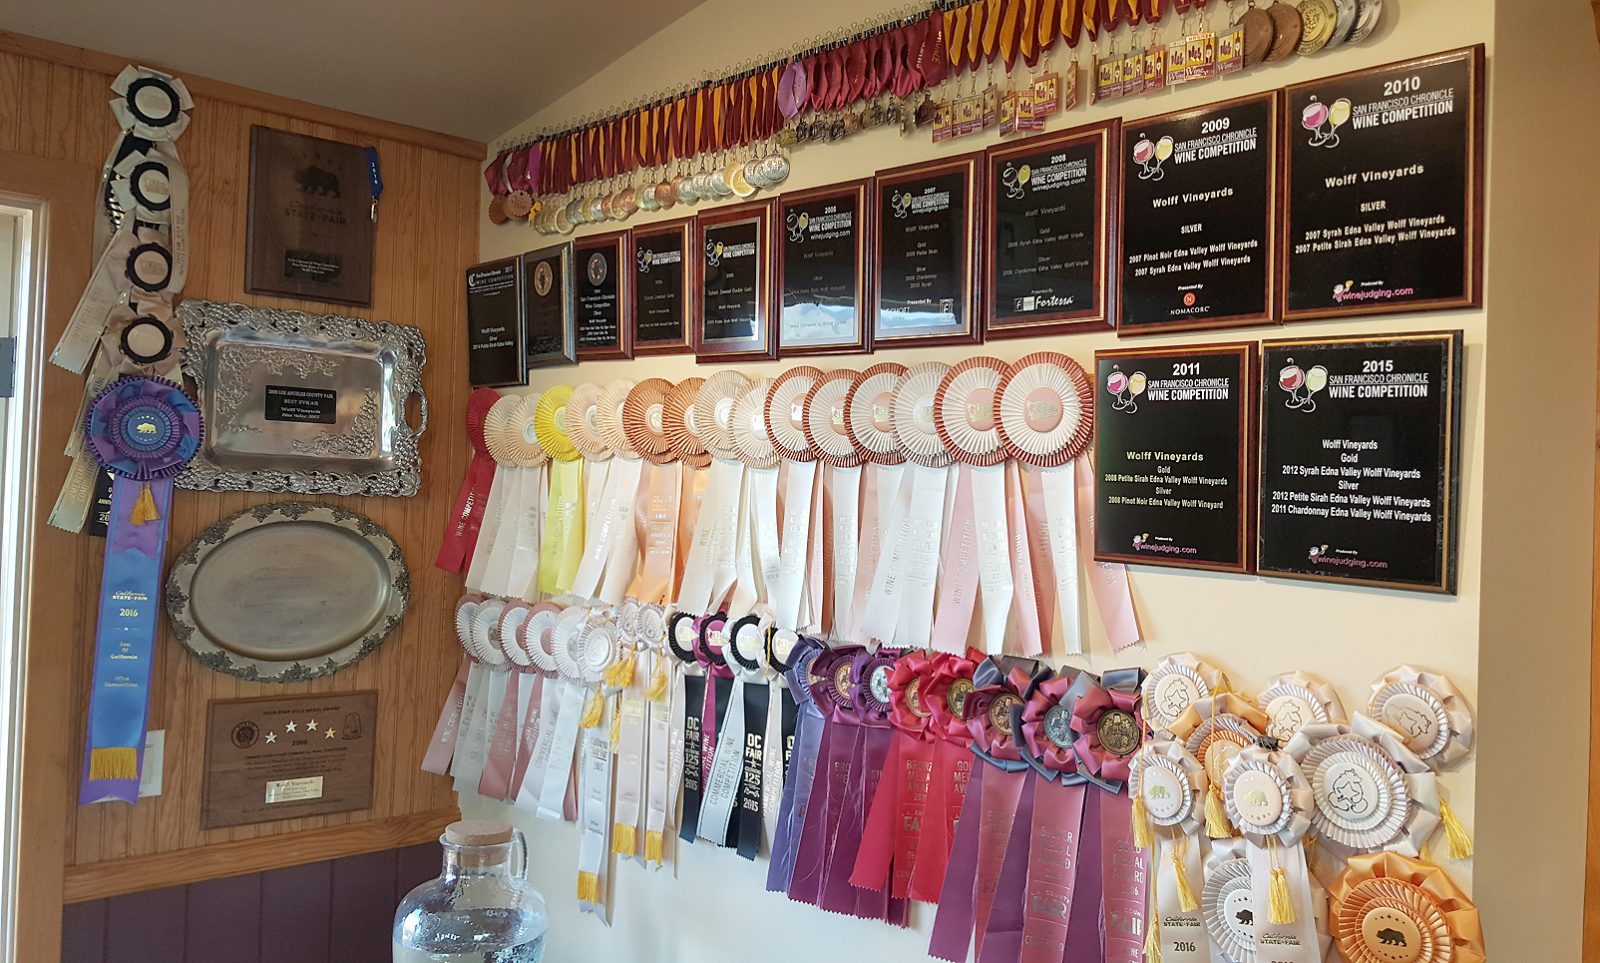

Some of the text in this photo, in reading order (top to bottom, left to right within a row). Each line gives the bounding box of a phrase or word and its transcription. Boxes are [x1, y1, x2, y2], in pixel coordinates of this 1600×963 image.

[1384, 76, 1420, 96] 2010
[1353, 88, 1454, 116] SAN FRANCISCO CHRONICLE
[1353, 100, 1453, 129] WINE COMPETITION
[1202, 118, 1230, 134] 2009
[1175, 127, 1257, 152] SAN FRANCISCO CHRONICLE
[1175, 137, 1256, 164] WINE COMPETITION
[1063, 158, 1087, 169] CHRONICLE
[1031, 168, 1087, 186] WINE COMPETITION
[1325, 164, 1424, 188] Wolff Vineyards
[1032, 178, 1085, 192] winejudging.com
[1153, 187, 1233, 208] Wolff Vineyards
[1361, 200, 1386, 212] SILVER
[1181, 224, 1202, 235] SILVER
[1305, 215, 1445, 240] 2007 Syrah Edna Valley Wolff Vineyards
[1313, 242, 1332, 252] Petite
[1334, 239, 1352, 249] Sirah
[1355, 237, 1372, 246] Edna
[1374, 234, 1395, 245] Valley
[1398, 231, 1417, 241] Wolff
[1419, 227, 1456, 239] Vineyards
[1143, 253, 1158, 262] Pinot
[1160, 251, 1172, 259] Noir
[1174, 249, 1188, 257] Edna
[1190, 247, 1207, 256] Valley
[1210, 244, 1225, 253] Wolff
[1227, 240, 1258, 251] Vineyards
[1150, 266, 1166, 276] Syrah
[1168, 264, 1181, 272] Edna
[1184, 261, 1201, 271] Valley
[1203, 259, 1219, 268] Wolff
[1221, 256, 1251, 266] Vineyards
[1343, 287, 1413, 301] winejudging.com
[1036, 296, 1073, 310] Fortessa
[1171, 306, 1209, 315] NOMACORC
[1173, 363, 1200, 376] 2011
[1363, 360, 1393, 373] 2015
[1148, 378, 1229, 388] SAN FRANCISCO CHRONICLE
[1329, 373, 1429, 384] SAN FRANCISCO CHRONICLE
[1148, 389, 1228, 401] WINE COMPETITION
[1329, 385, 1427, 398] WINE COMPETITION
[1322, 440, 1378, 450] Wolff Vineyards
[1127, 451, 1204, 463] Wolff Vineyards
[1341, 454, 1358, 463] Gold
[1158, 466, 1170, 474] Gold
[1282, 465, 1420, 480] 2012 Syrah Edna Valley Wolff Vineyards
[1118, 474, 1133, 482] Petite
[1134, 475, 1148, 483] Sirah
[1150, 475, 1163, 483] Edna
[1165, 476, 1181, 485] Valley
[1199, 477, 1227, 486] Vineyards
[1338, 481, 1359, 490] Silver
[1156, 487, 1172, 495] Silver
[1122, 497, 1135, 505] Pinot
[1149, 498, 1162, 506] Edna
[1164, 499, 1180, 508] Valley
[1182, 500, 1197, 508] Wolff
[1198, 501, 1223, 510] Vineyard
[1273, 492, 1430, 508] 2012 Petite Sirah Edna Valley Wolff Vineyards
[1272, 504, 1431, 522] 2011 Chardonnay Edna Valley Wolff Vineyards
[1140, 543, 1197, 555] winejudging.com
[1317, 556, 1387, 569] winejudging.com
[120, 608, 138, 617] 2016
[687, 716, 699, 730] OC
[747, 733, 761, 749] OC
[685, 753, 699, 765] 125
[746, 747, 762, 760] FAIR
[744, 771, 760, 785] 125
[743, 798, 758, 812] 2015
[1174, 942, 1196, 952] 2016
